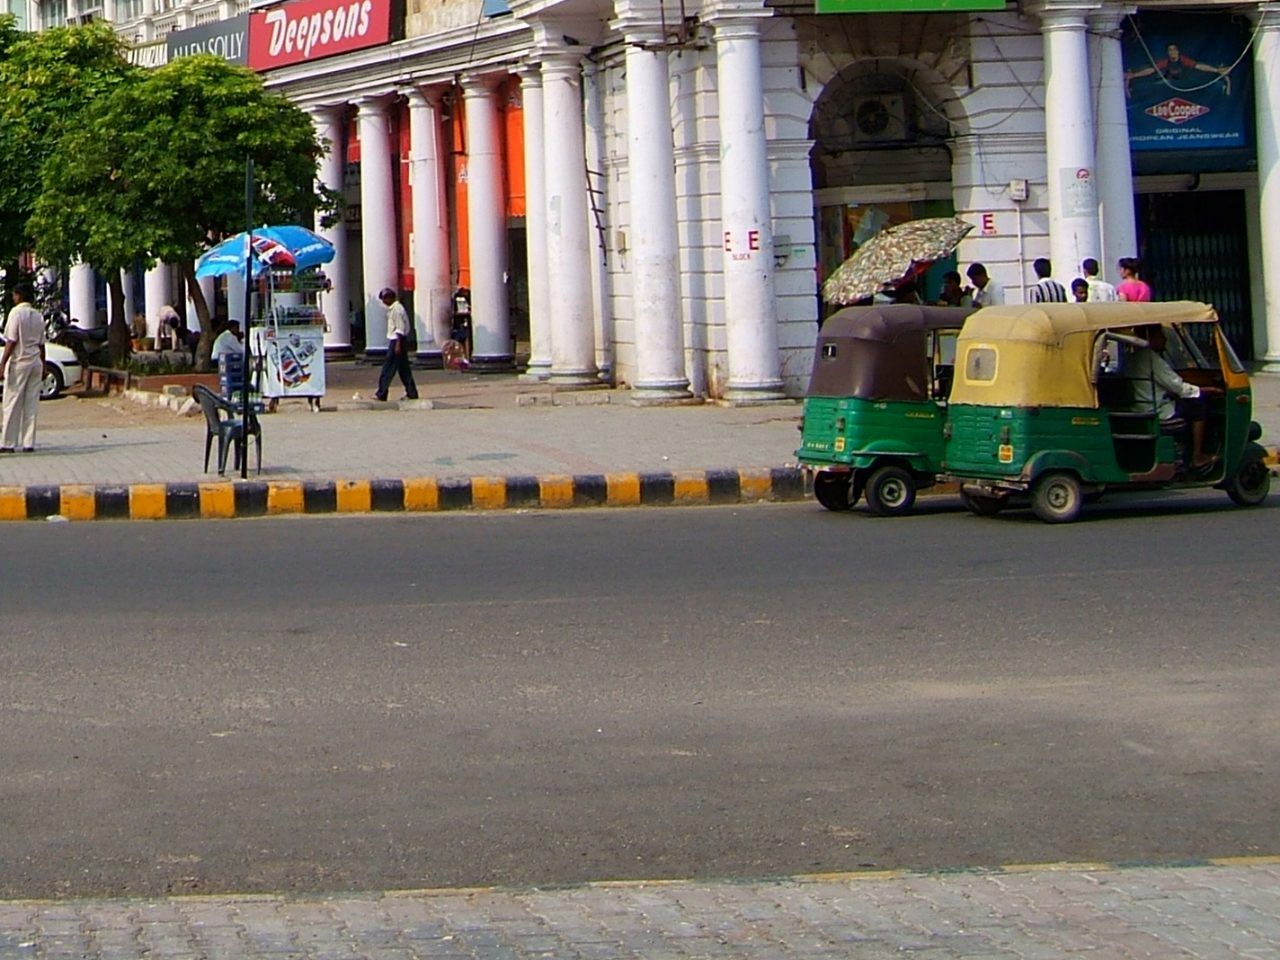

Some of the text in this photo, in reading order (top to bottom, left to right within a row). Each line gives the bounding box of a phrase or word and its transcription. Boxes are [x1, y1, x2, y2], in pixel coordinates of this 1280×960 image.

[265, 0, 372, 58] Deepsons
[208, 32, 245, 60] SOLLY
[982, 214, 995, 230] E
[748, 230, 760, 251] E
